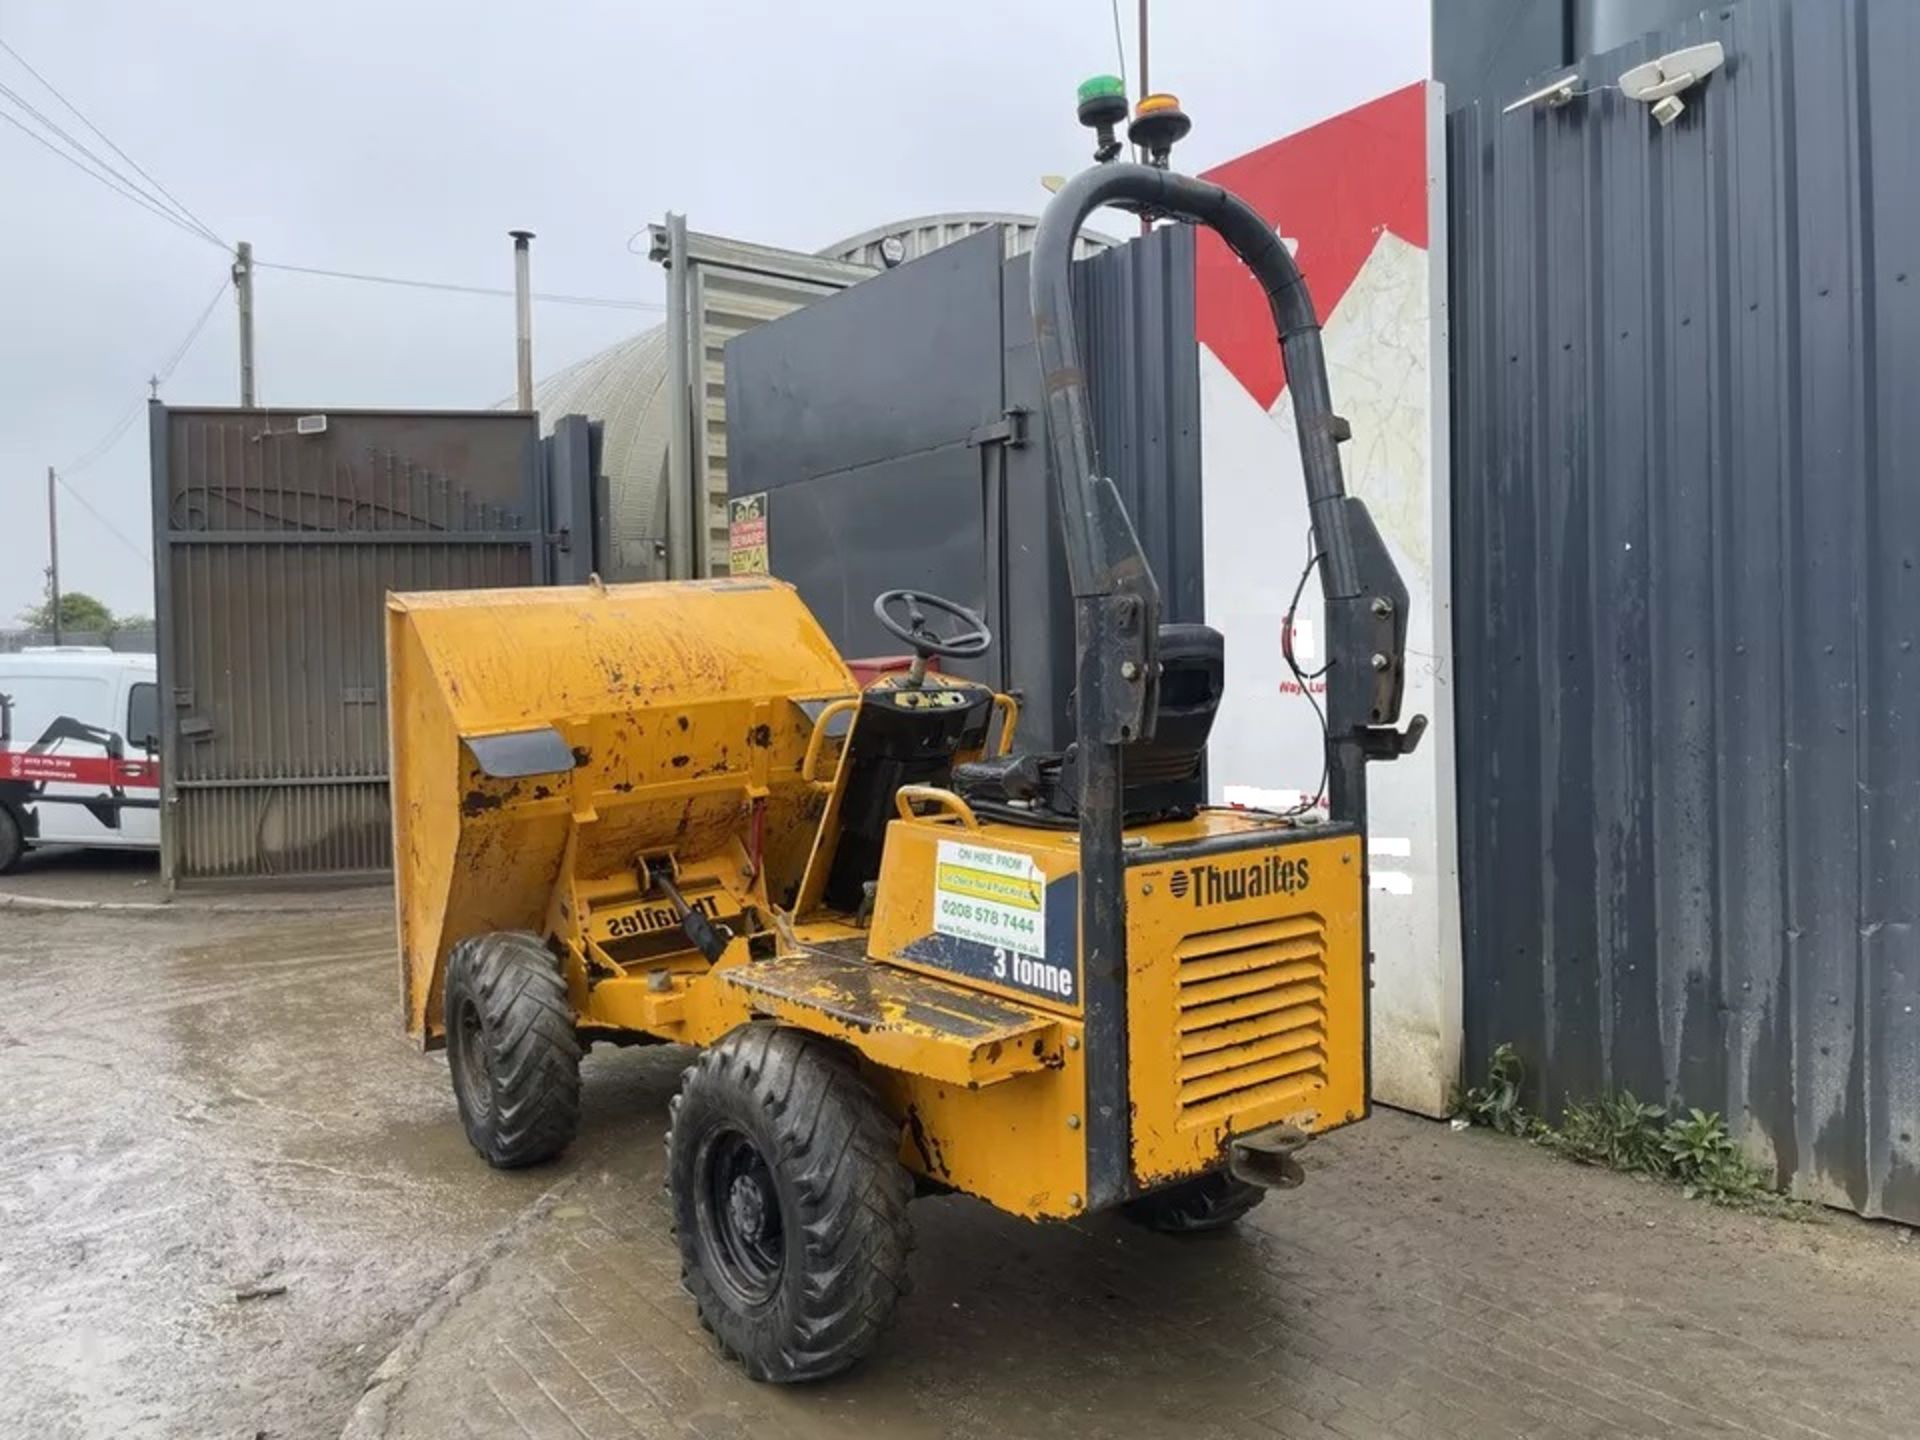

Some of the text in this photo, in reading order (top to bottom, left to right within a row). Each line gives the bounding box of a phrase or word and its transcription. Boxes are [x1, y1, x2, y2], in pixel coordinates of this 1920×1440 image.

[1191, 855, 1309, 907] Thwaites
[942, 900, 1034, 934] 0208 578 7444
[993, 949, 1072, 995] 3 tonne
